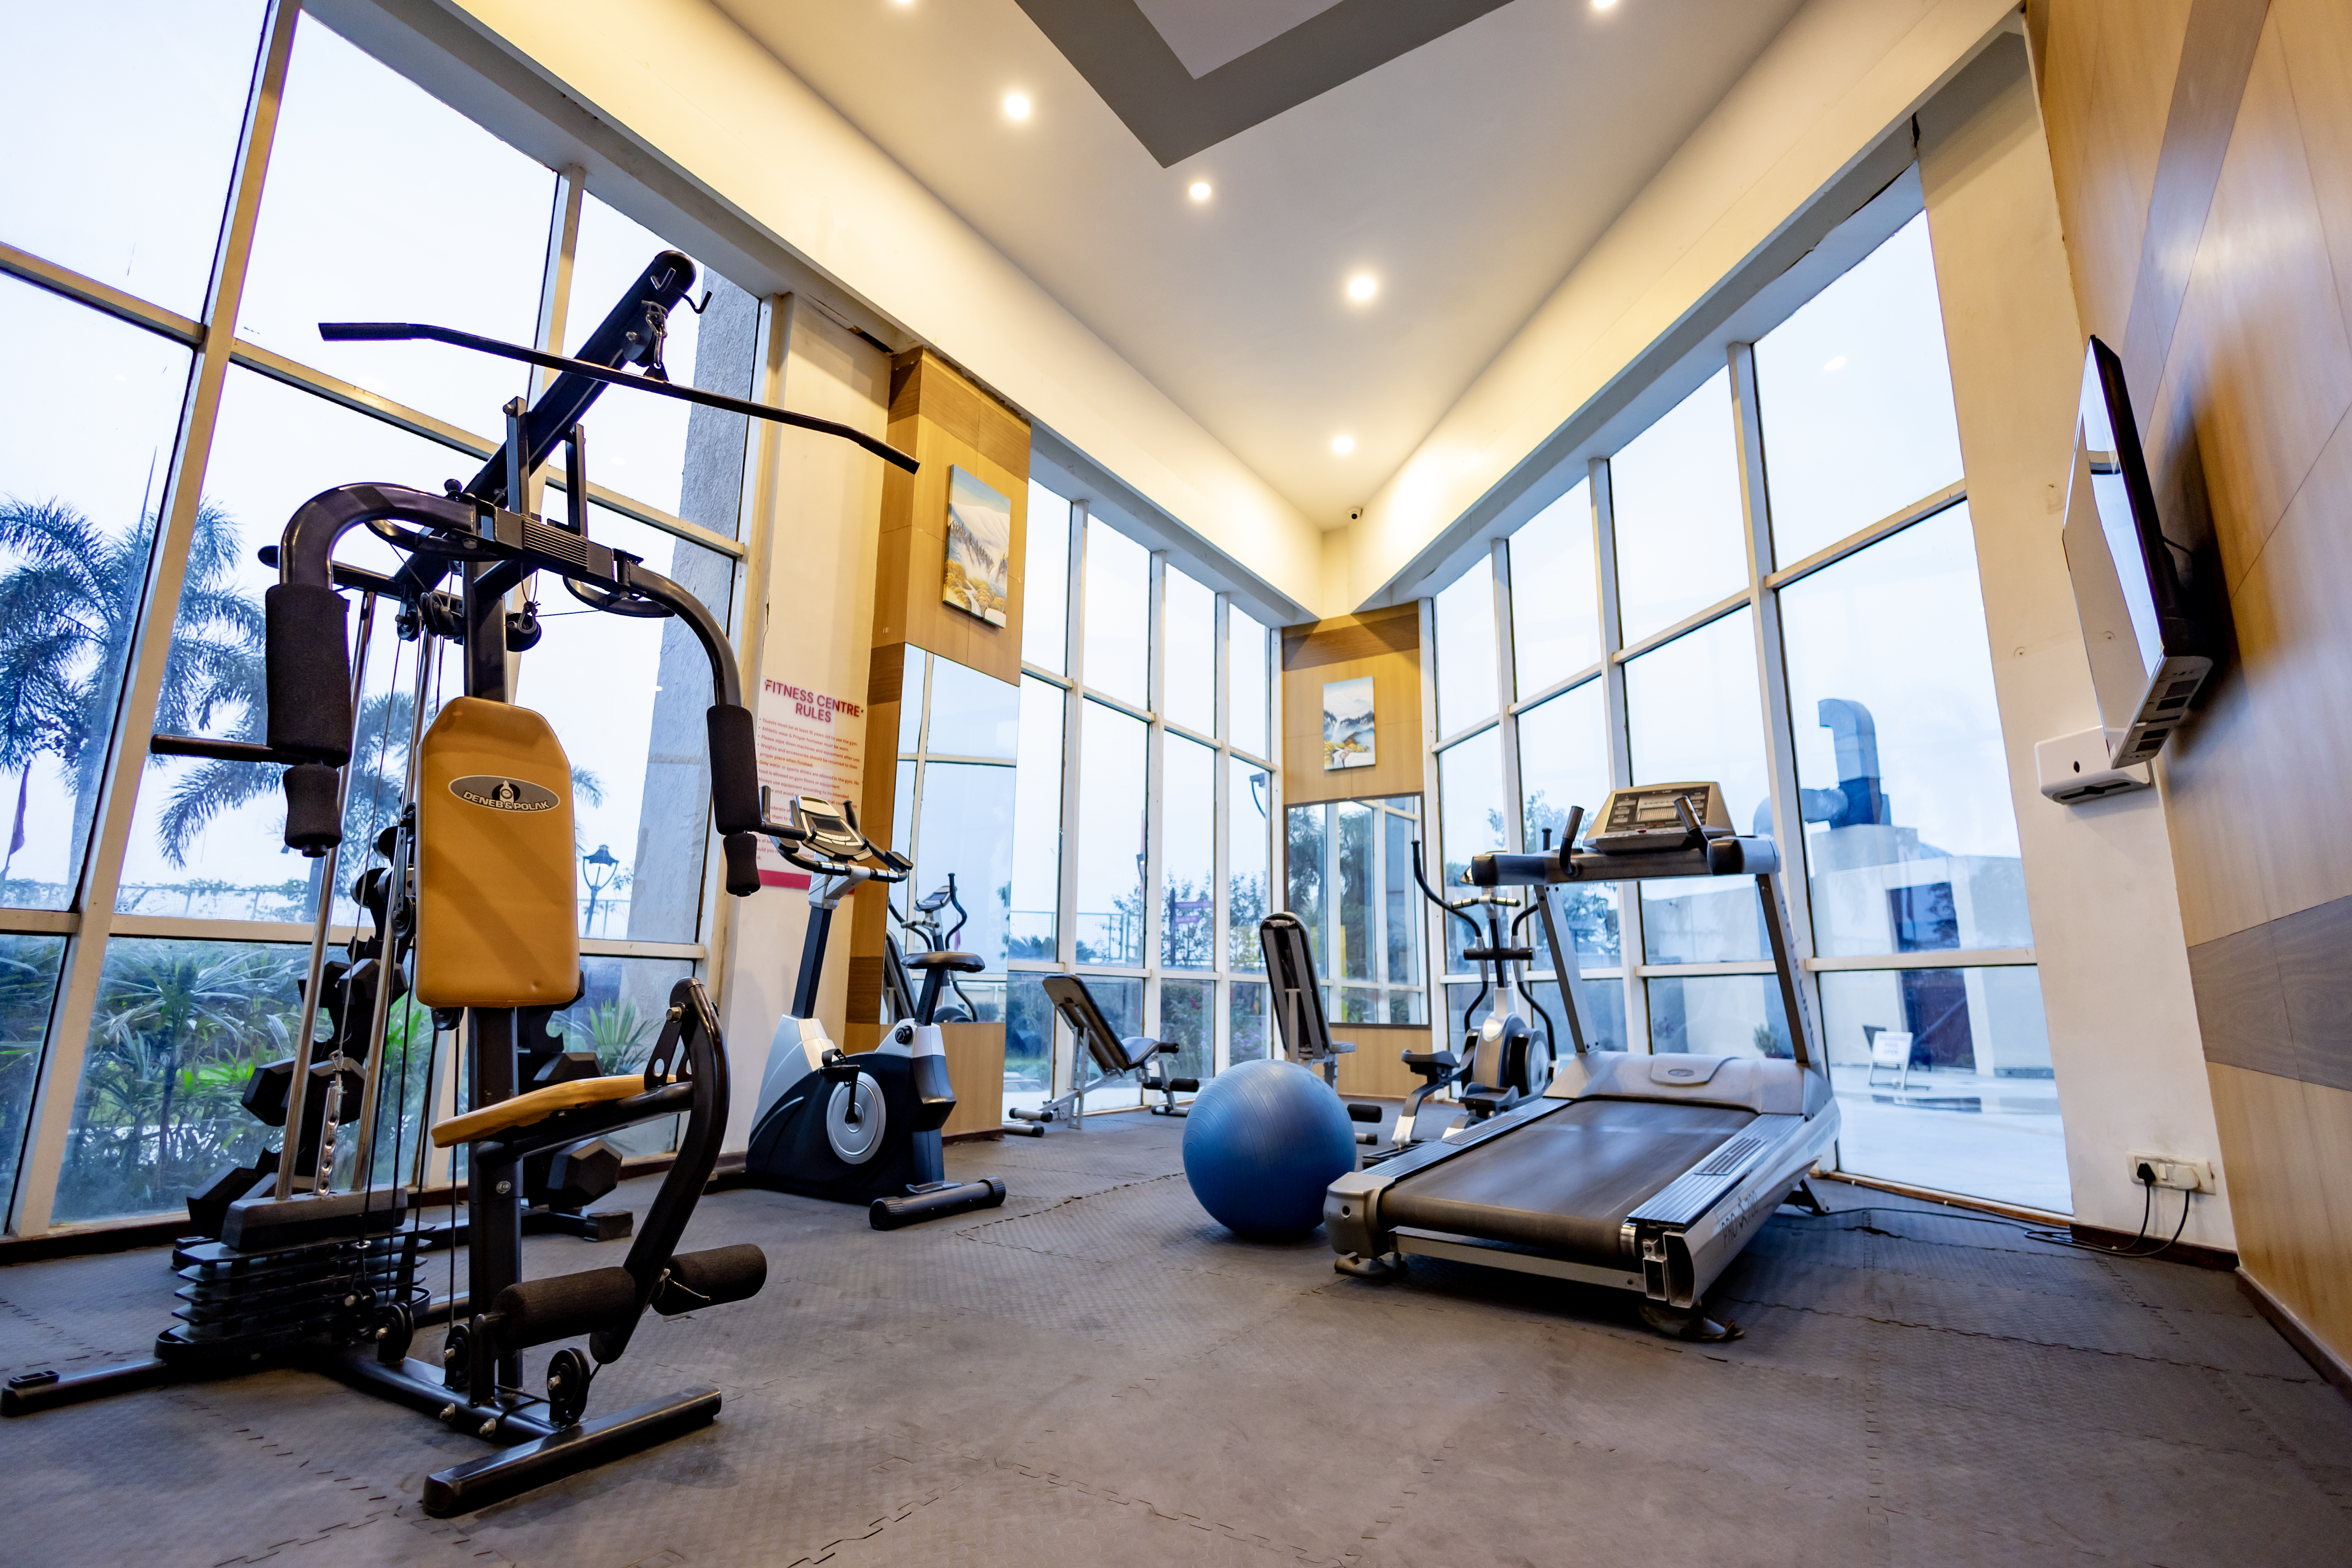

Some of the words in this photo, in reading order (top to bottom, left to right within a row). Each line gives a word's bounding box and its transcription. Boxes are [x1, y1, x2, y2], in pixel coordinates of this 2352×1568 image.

[764, 679, 813, 703] FITNESS
[817, 695, 860, 717] CENTRE
[795, 703, 831, 722] RULES
[463, 791, 504, 808] DENEB
[1720, 1212, 1738, 1248] PRO
